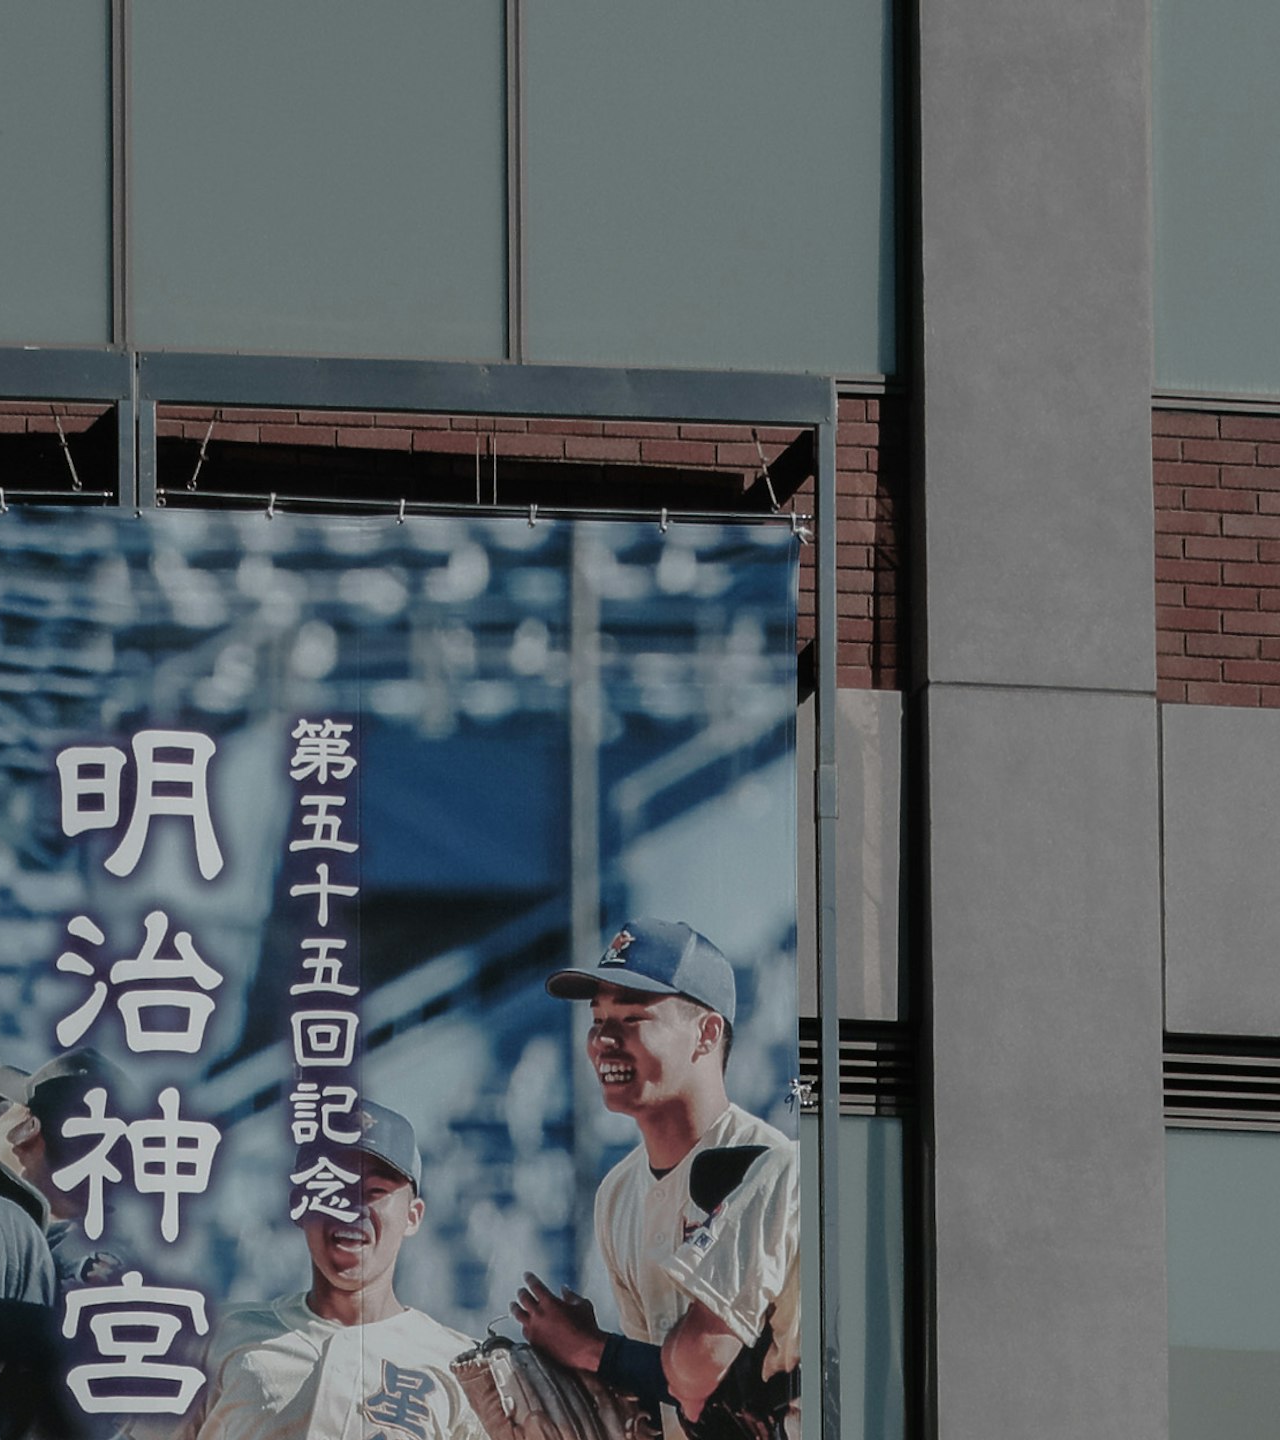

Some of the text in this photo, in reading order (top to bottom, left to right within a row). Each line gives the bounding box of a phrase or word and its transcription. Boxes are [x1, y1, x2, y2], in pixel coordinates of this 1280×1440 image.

[288, 719, 362, 1224] 第五十五回記念
